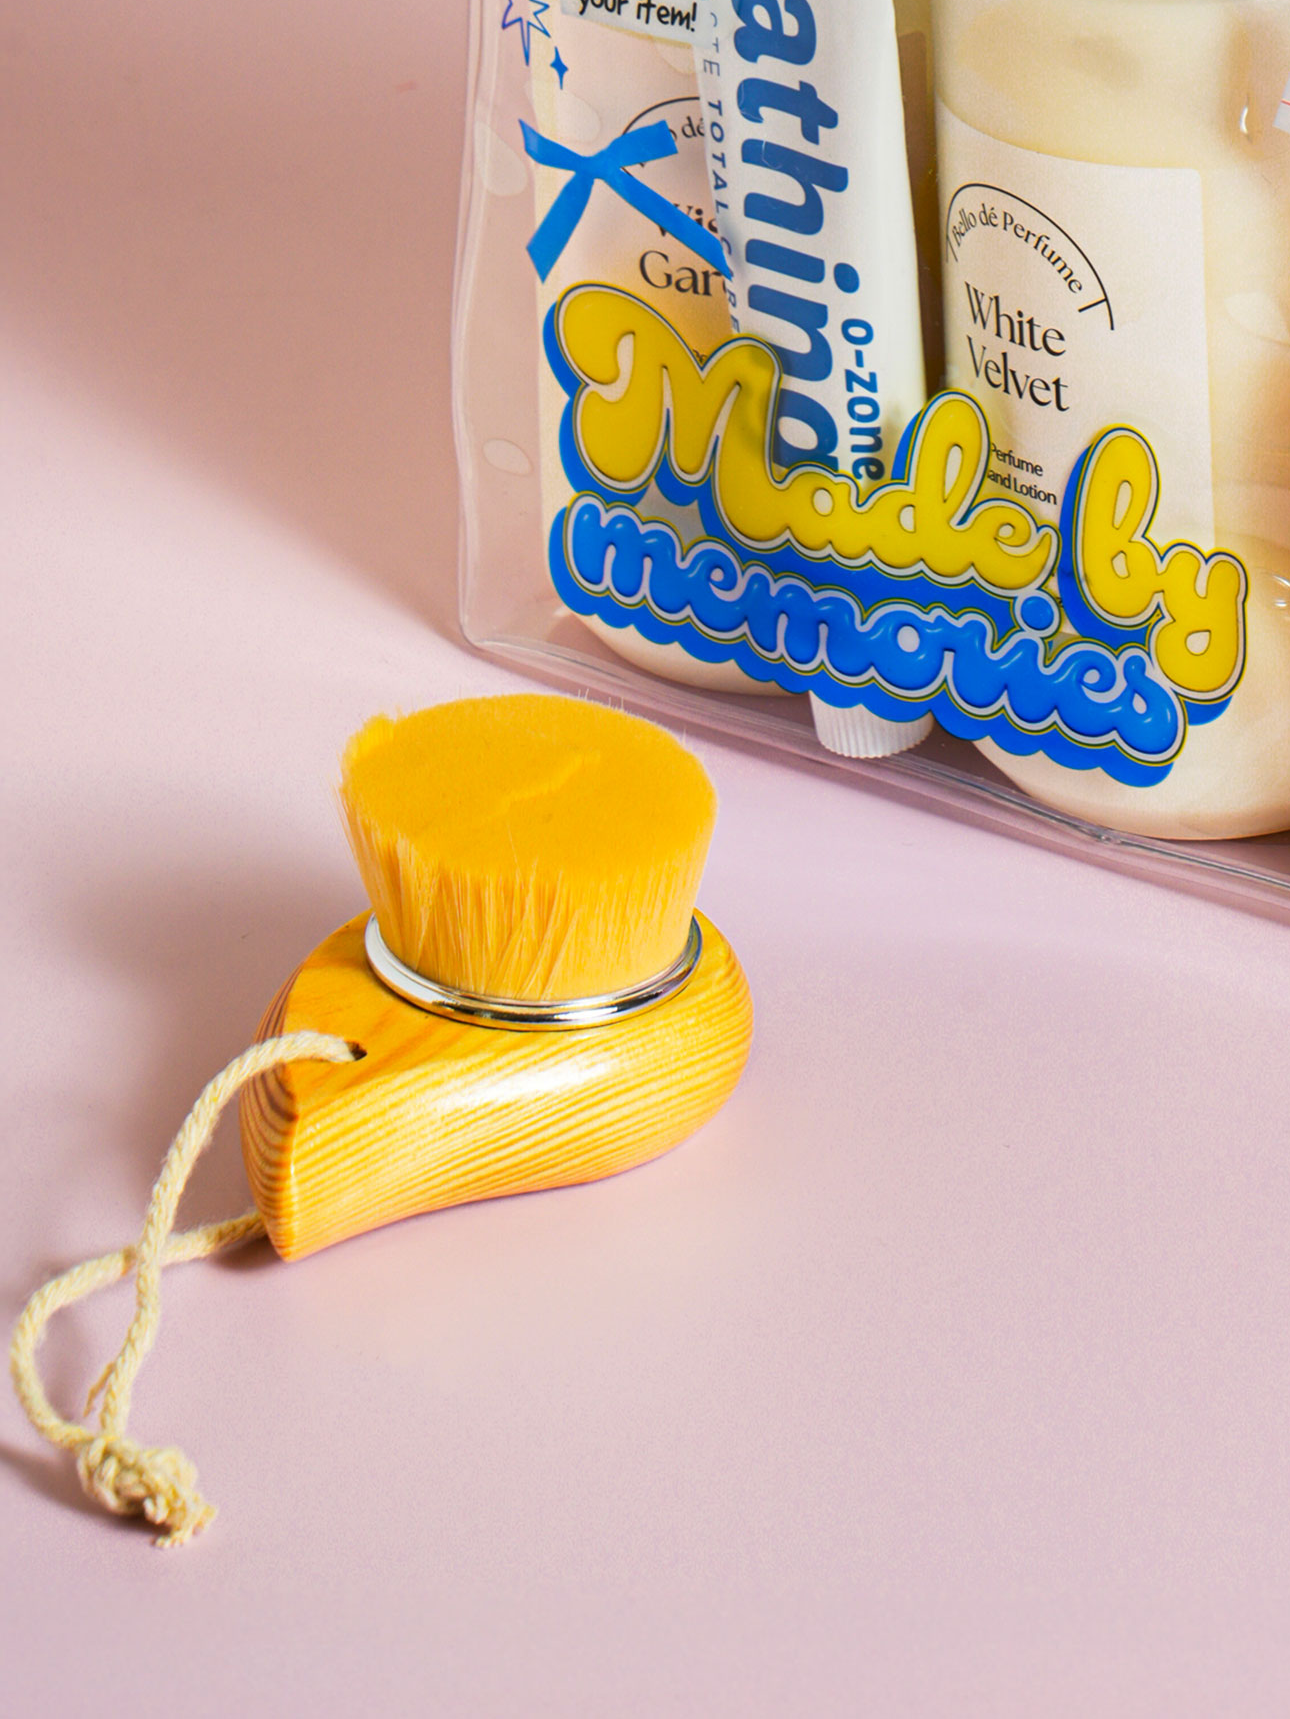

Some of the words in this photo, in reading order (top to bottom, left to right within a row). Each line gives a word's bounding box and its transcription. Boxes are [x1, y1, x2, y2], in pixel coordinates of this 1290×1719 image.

[708, 100, 729, 214] TOTAL
[639, 250, 728, 297] Gar
[952, 208, 977, 248] Bello
[979, 202, 998, 228] dé
[1002, 210, 1083, 295] Perfume
[964, 281, 1066, 357] White
[841, 318, 885, 481] o-zone
[966, 334, 1070, 412] Velvet
[556, 284, 1060, 599] Made
[1068, 424, 1248, 703] by
[1013, 477, 1057, 506] Lotion
[560, 491, 1189, 771] memories
